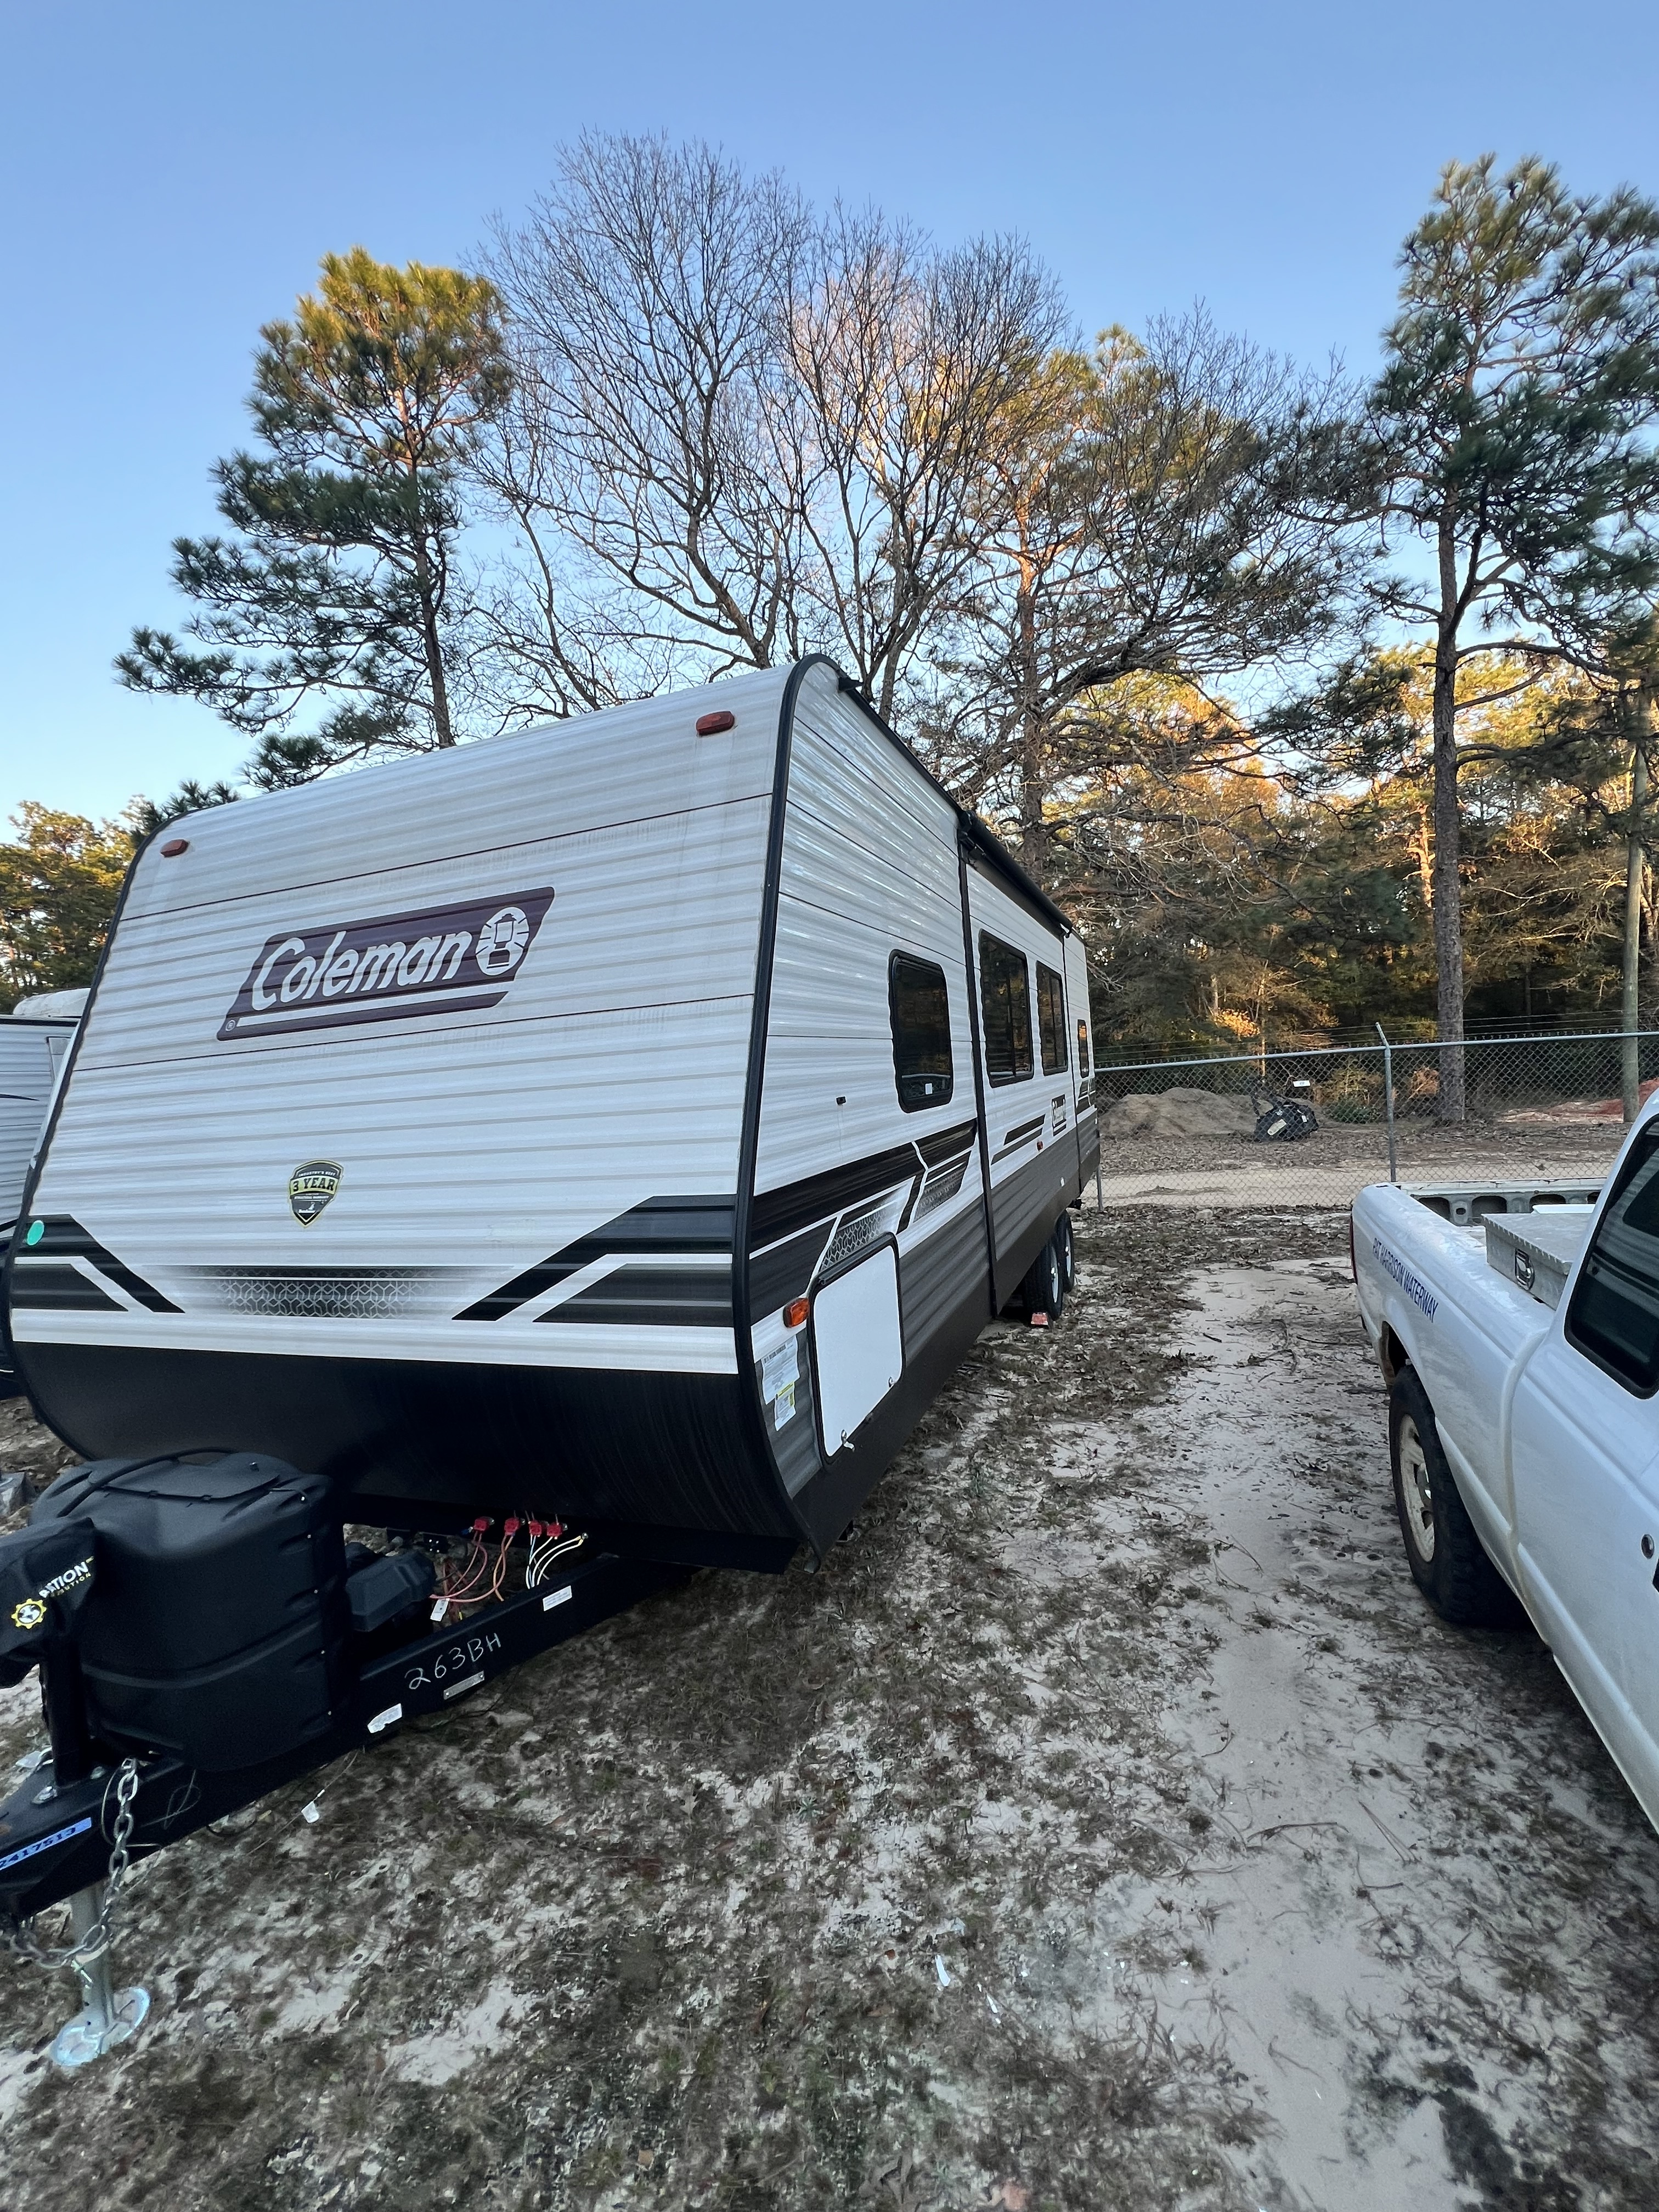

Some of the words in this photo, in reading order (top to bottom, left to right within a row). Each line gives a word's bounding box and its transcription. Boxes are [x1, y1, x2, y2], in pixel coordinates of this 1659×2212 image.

[252, 930, 473, 1011] Coleman
[293, 1180, 300, 1192] 3
[303, 1177, 335, 1191] YEAR
[1403, 1269, 1439, 1323] WATERWAY
[404, 1633, 501, 1690] 263BH
